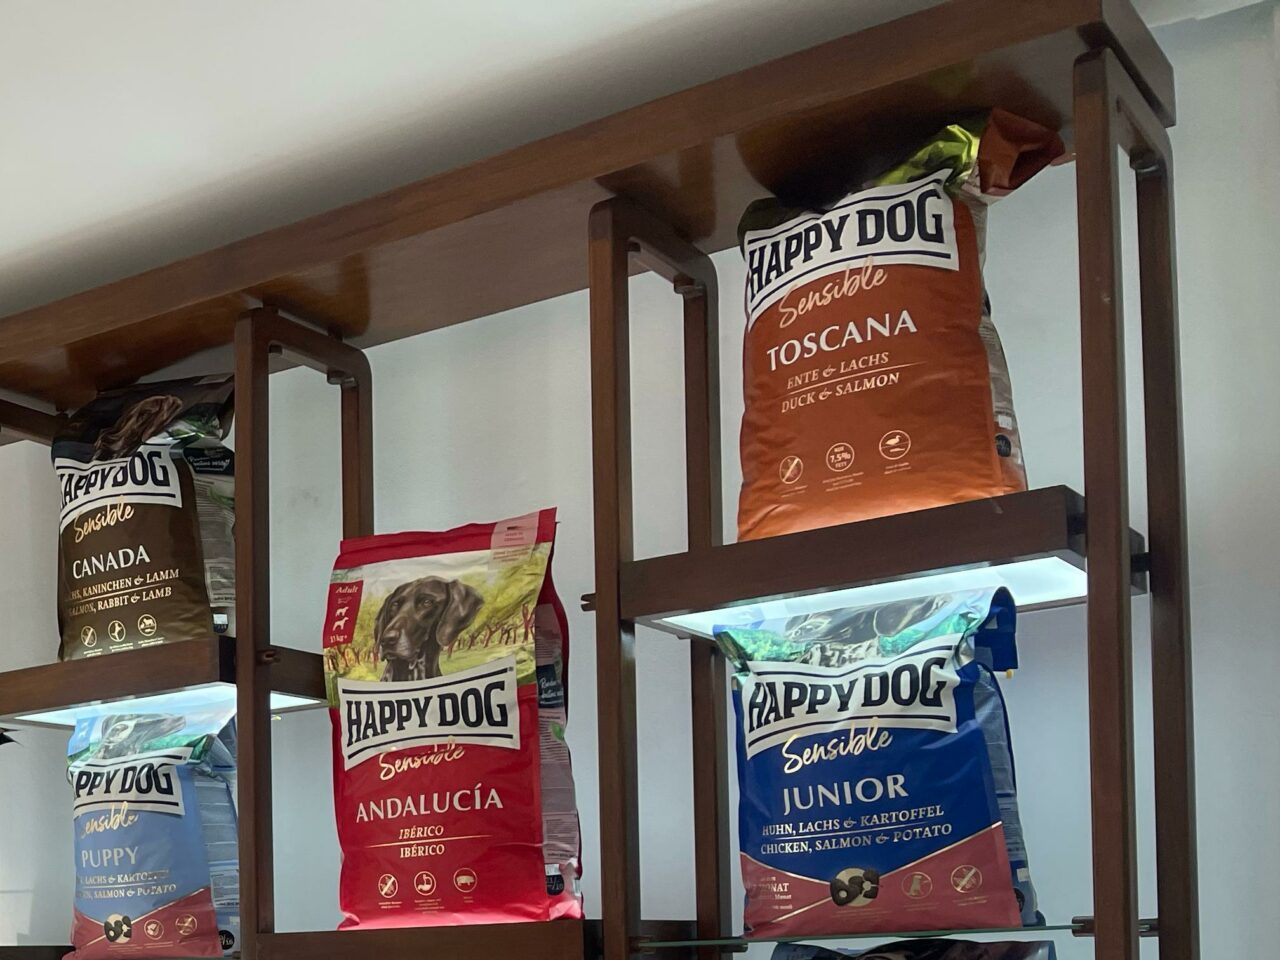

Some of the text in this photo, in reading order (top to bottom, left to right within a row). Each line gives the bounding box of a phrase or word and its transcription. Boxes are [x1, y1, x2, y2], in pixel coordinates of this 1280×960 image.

[748, 189, 945, 300] HAPPY DOG
[778, 256, 888, 329] Sensible
[767, 309, 917, 372] TOSCANA
[787, 352, 889, 389] ENTE & LACHS
[781, 372, 900, 413] DUCK & SALMON
[112, 450, 170, 487] DOG
[74, 494, 134, 543] Sensible
[72, 545, 151, 579] CANADA
[82, 568, 179, 597] KANINCHEN & LAMM
[97, 587, 172, 610] RABBIT & LAMB
[336, 585, 359, 594] Adult
[748, 656, 948, 734] HAPPY DOG
[346, 681, 509, 747] HAPPY DOG
[379, 735, 465, 781] Sensible
[781, 716, 894, 775] Sensible
[119, 763, 174, 795] DOG
[783, 773, 909, 816] JUNIOR
[355, 783, 504, 823] ANDALUCÍA
[762, 805, 944, 837] HUHN, LACHS & KARTOFFEL
[398, 824, 445, 840] IBÉRICO
[399, 842, 446, 859] IBÉRICO
[761, 823, 953, 855] CHICKEN, SALMON & POTATO
[81, 846, 138, 868] PUPPY
